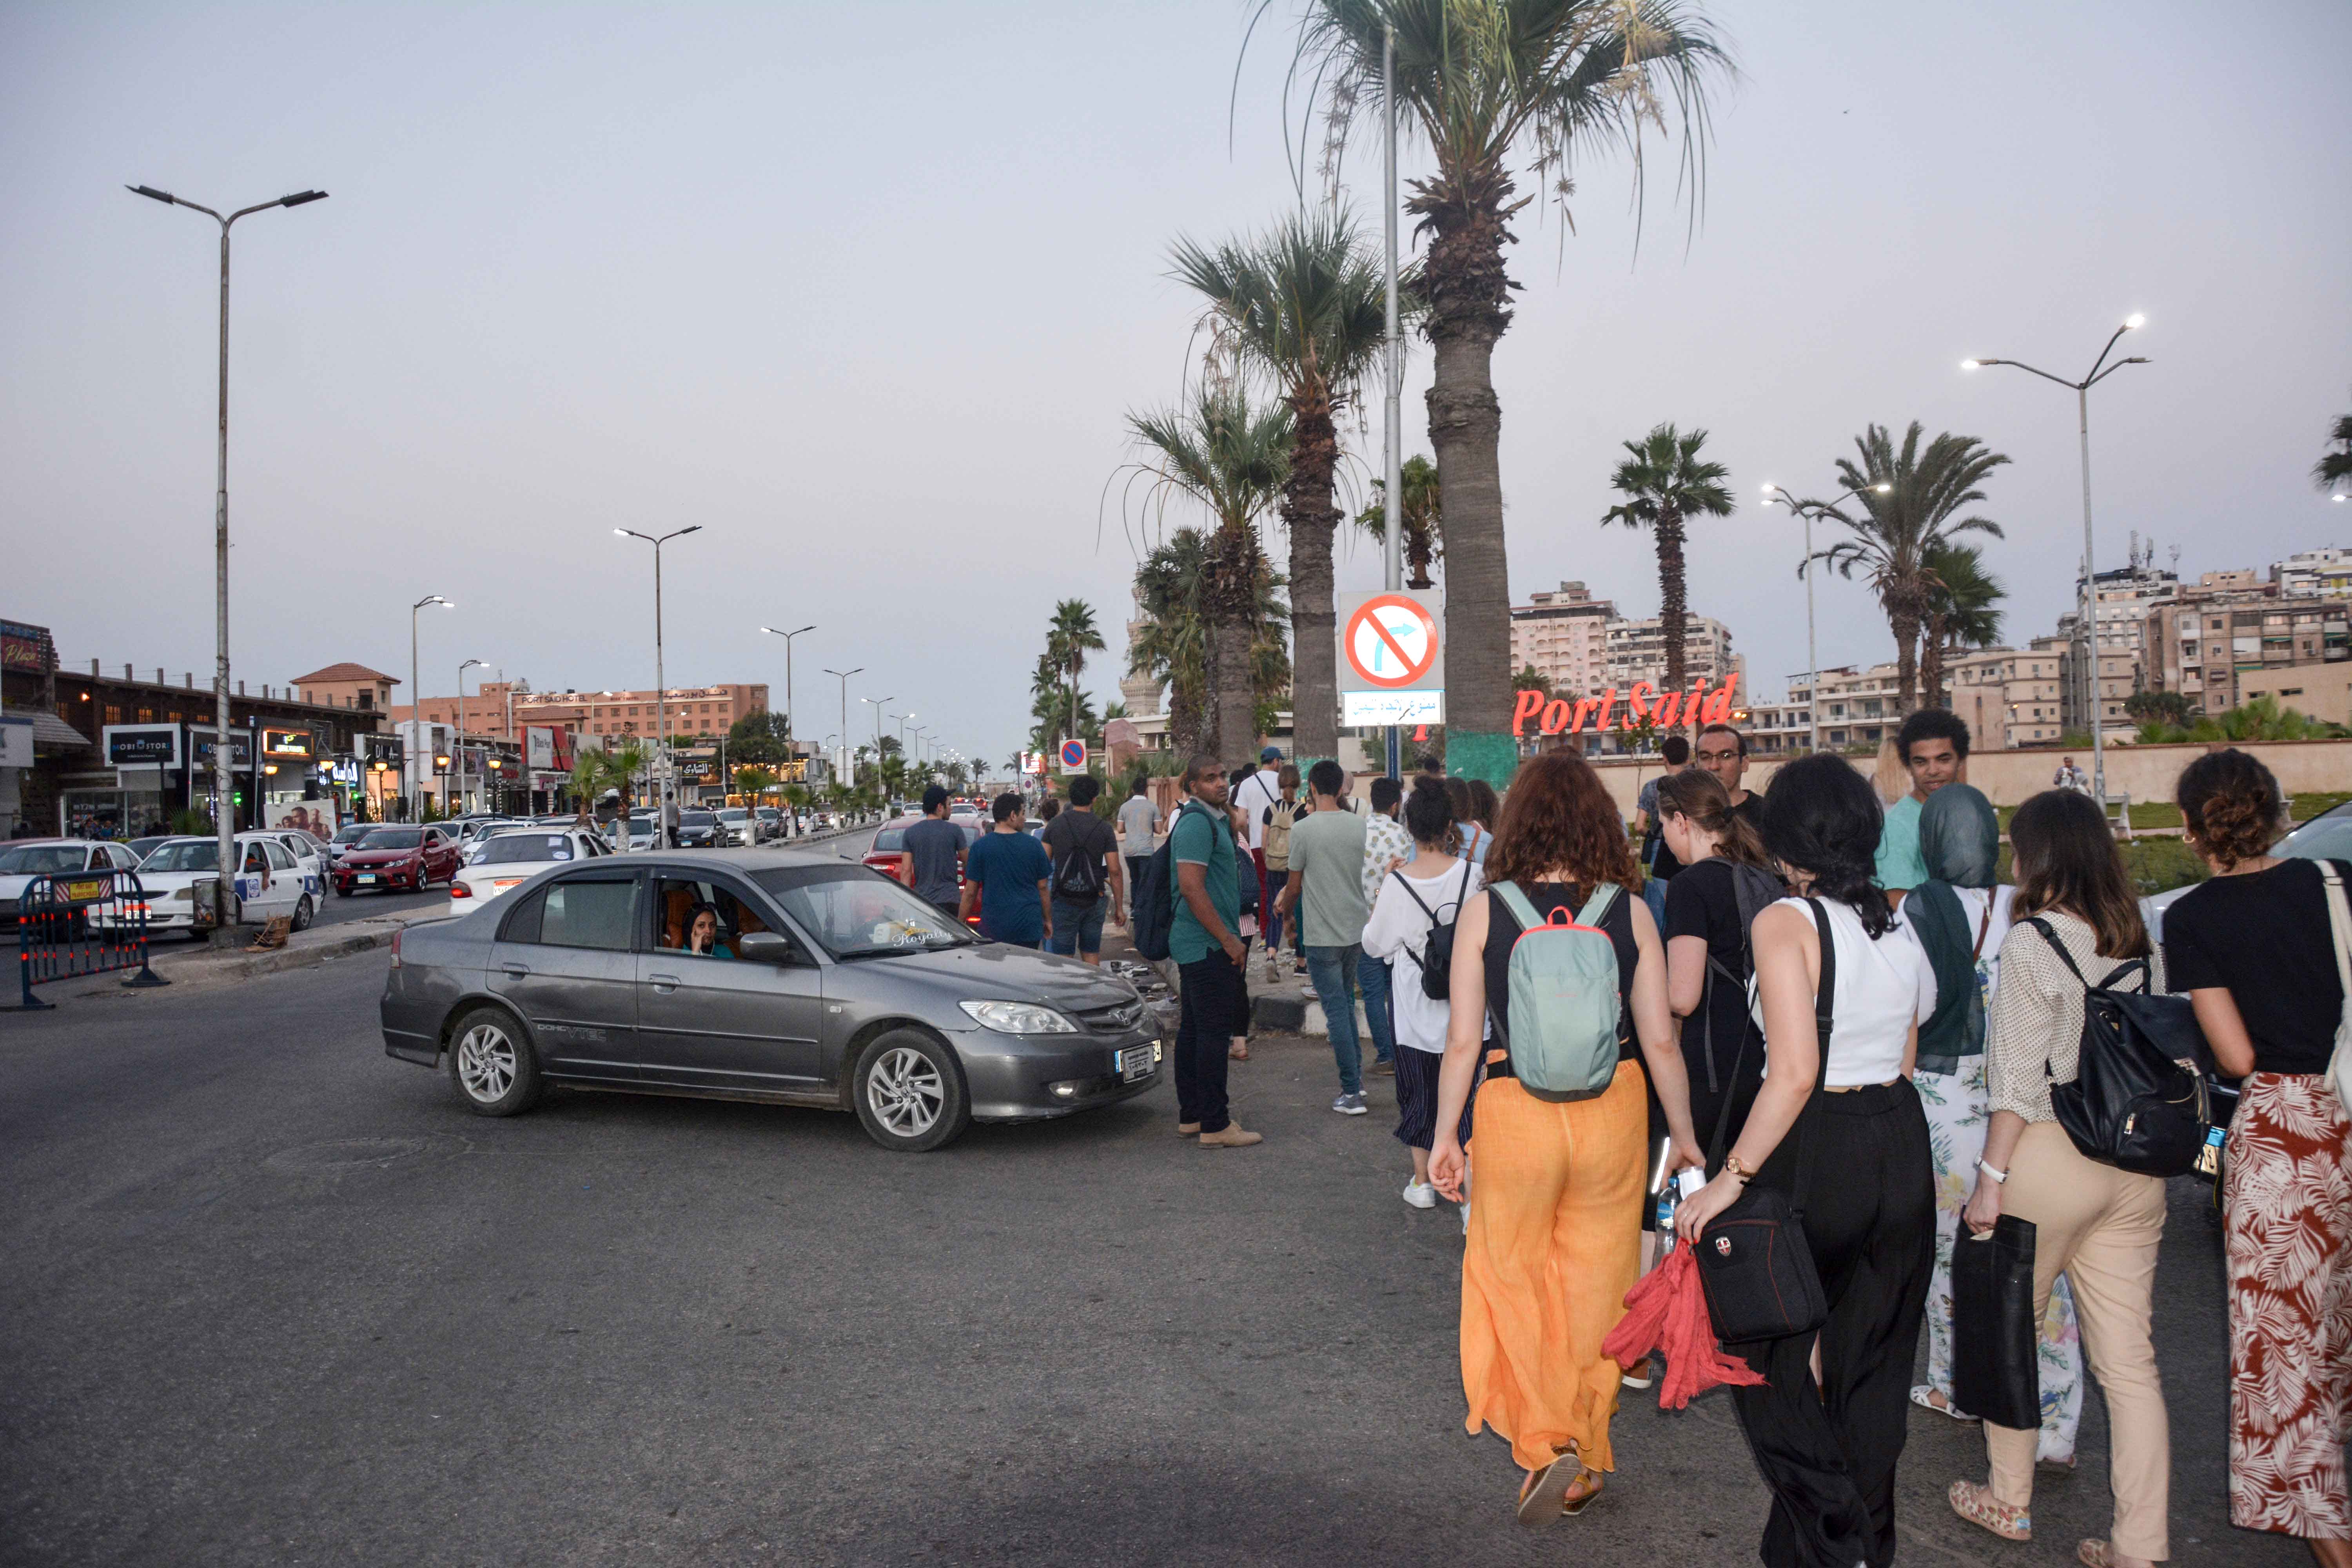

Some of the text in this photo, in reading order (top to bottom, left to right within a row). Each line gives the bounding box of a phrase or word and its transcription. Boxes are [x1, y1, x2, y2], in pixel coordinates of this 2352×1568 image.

[699, 689, 728, 698] فندق
[1513, 672, 1739, 737] Port Said
[1063, 883, 1090, 892] adidas
[892, 927, 953, 947] Royalty
[566, 1026, 606, 1041] VTEC
